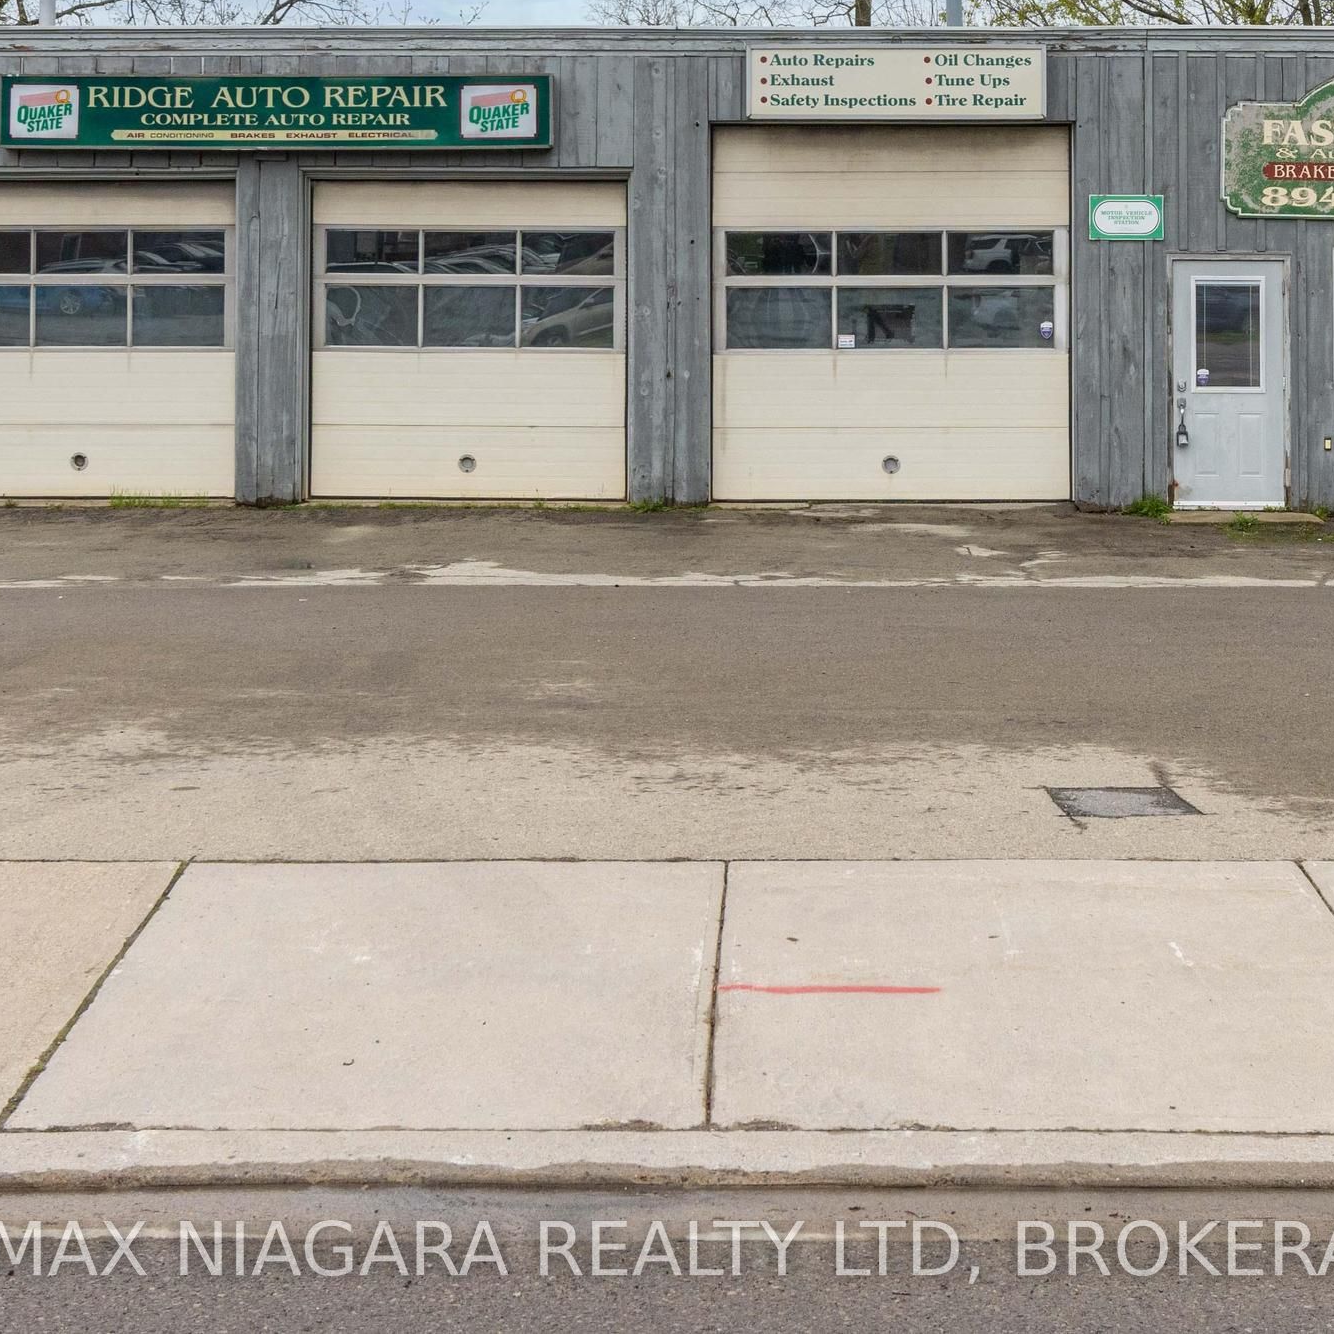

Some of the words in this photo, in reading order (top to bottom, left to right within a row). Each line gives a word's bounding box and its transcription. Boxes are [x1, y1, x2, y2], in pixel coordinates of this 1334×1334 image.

[770, 54, 808, 67] Auto
[813, 54, 875, 69] Repairs
[934, 53, 960, 67] Oil
[963, 54, 1032, 69] Changes
[770, 74, 835, 87] Exhaust
[934, 74, 975, 87] Tune
[980, 74, 1010, 88] Ups
[87, 86, 193, 108] RIDGE
[211, 86, 310, 108] AUTO
[323, 86, 447, 108] REPAIR
[770, 94, 819, 108] Safety
[823, 94, 916, 108] Inspections
[934, 94, 969, 107] Tire
[972, 94, 1027, 108] Repair
[17, 103, 73, 124] QUAKER
[141, 113, 259, 126] COMPLETE
[266, 113, 325, 126] AUTO
[332, 113, 410, 126] REPAIR
[469, 103, 530, 124] QUAKER
[27, 117, 63, 133] STATE
[479, 117, 519, 133] STATE
[1275, 148, 1299, 160] &
